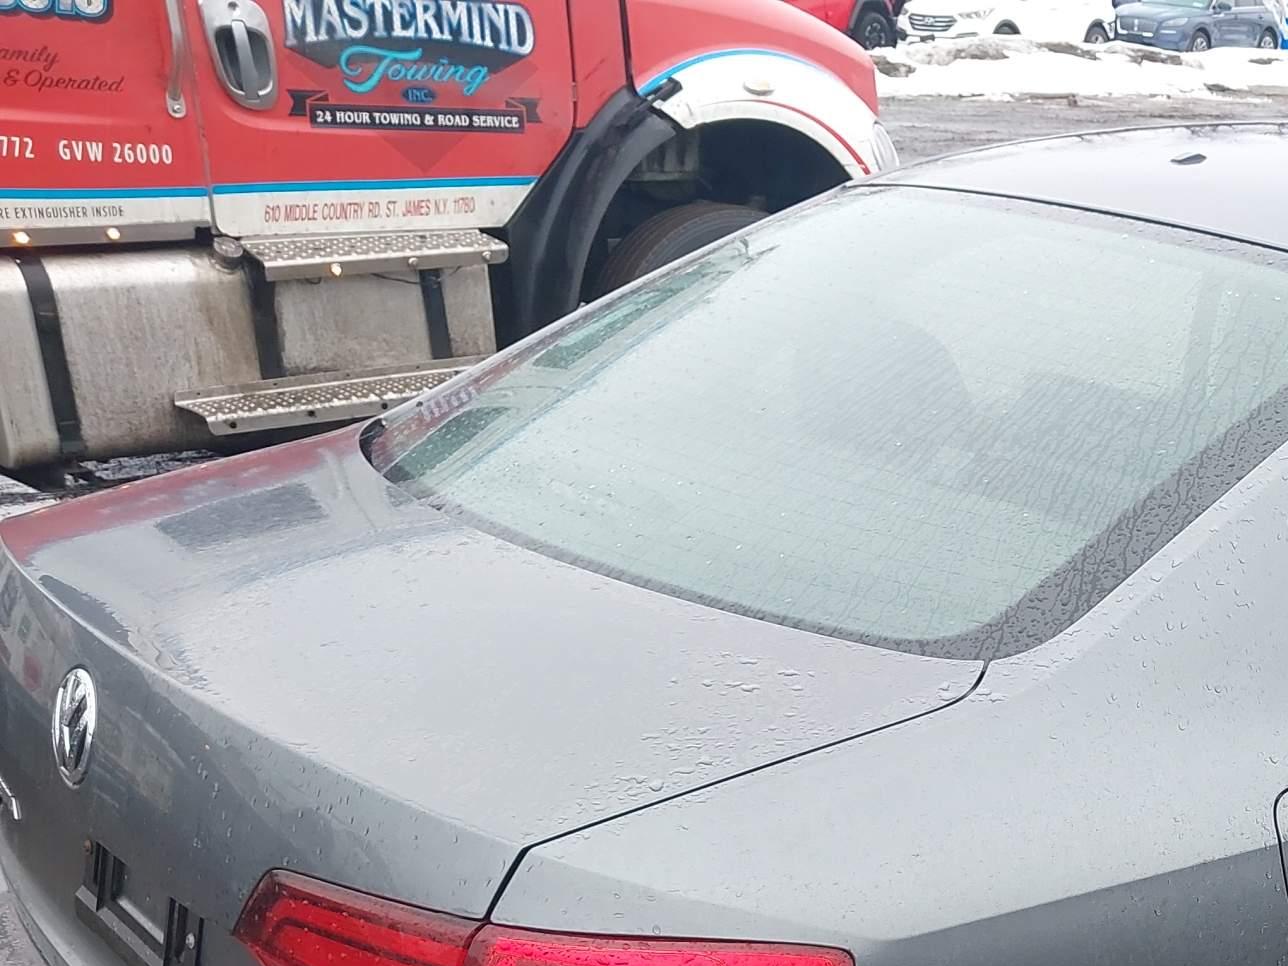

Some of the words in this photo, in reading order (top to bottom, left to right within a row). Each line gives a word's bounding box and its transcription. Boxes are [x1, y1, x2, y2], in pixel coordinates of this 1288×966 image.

[284, 0, 535, 55] MASTERMIND
[3, 69, 20, 87] &
[339, 44, 490, 96] Towing
[316, 110, 332, 123] 24
[336, 110, 370, 124] HOUR
[373, 112, 420, 126] TOWING
[424, 114, 434, 126] &
[438, 115, 468, 127] ROAD
[472, 115, 519, 128] SERVICE
[58, 139, 103, 162] GVW
[112, 142, 173, 165] 26000
[14, 206, 88, 219] EXTINGUISHER
[92, 204, 124, 217] INSIDE
[264, 204, 281, 223] 610
[283, 203, 318, 221] MIDDLE
[322, 201, 364, 220] COUNTRY
[402, 198, 431, 216] JAMES
